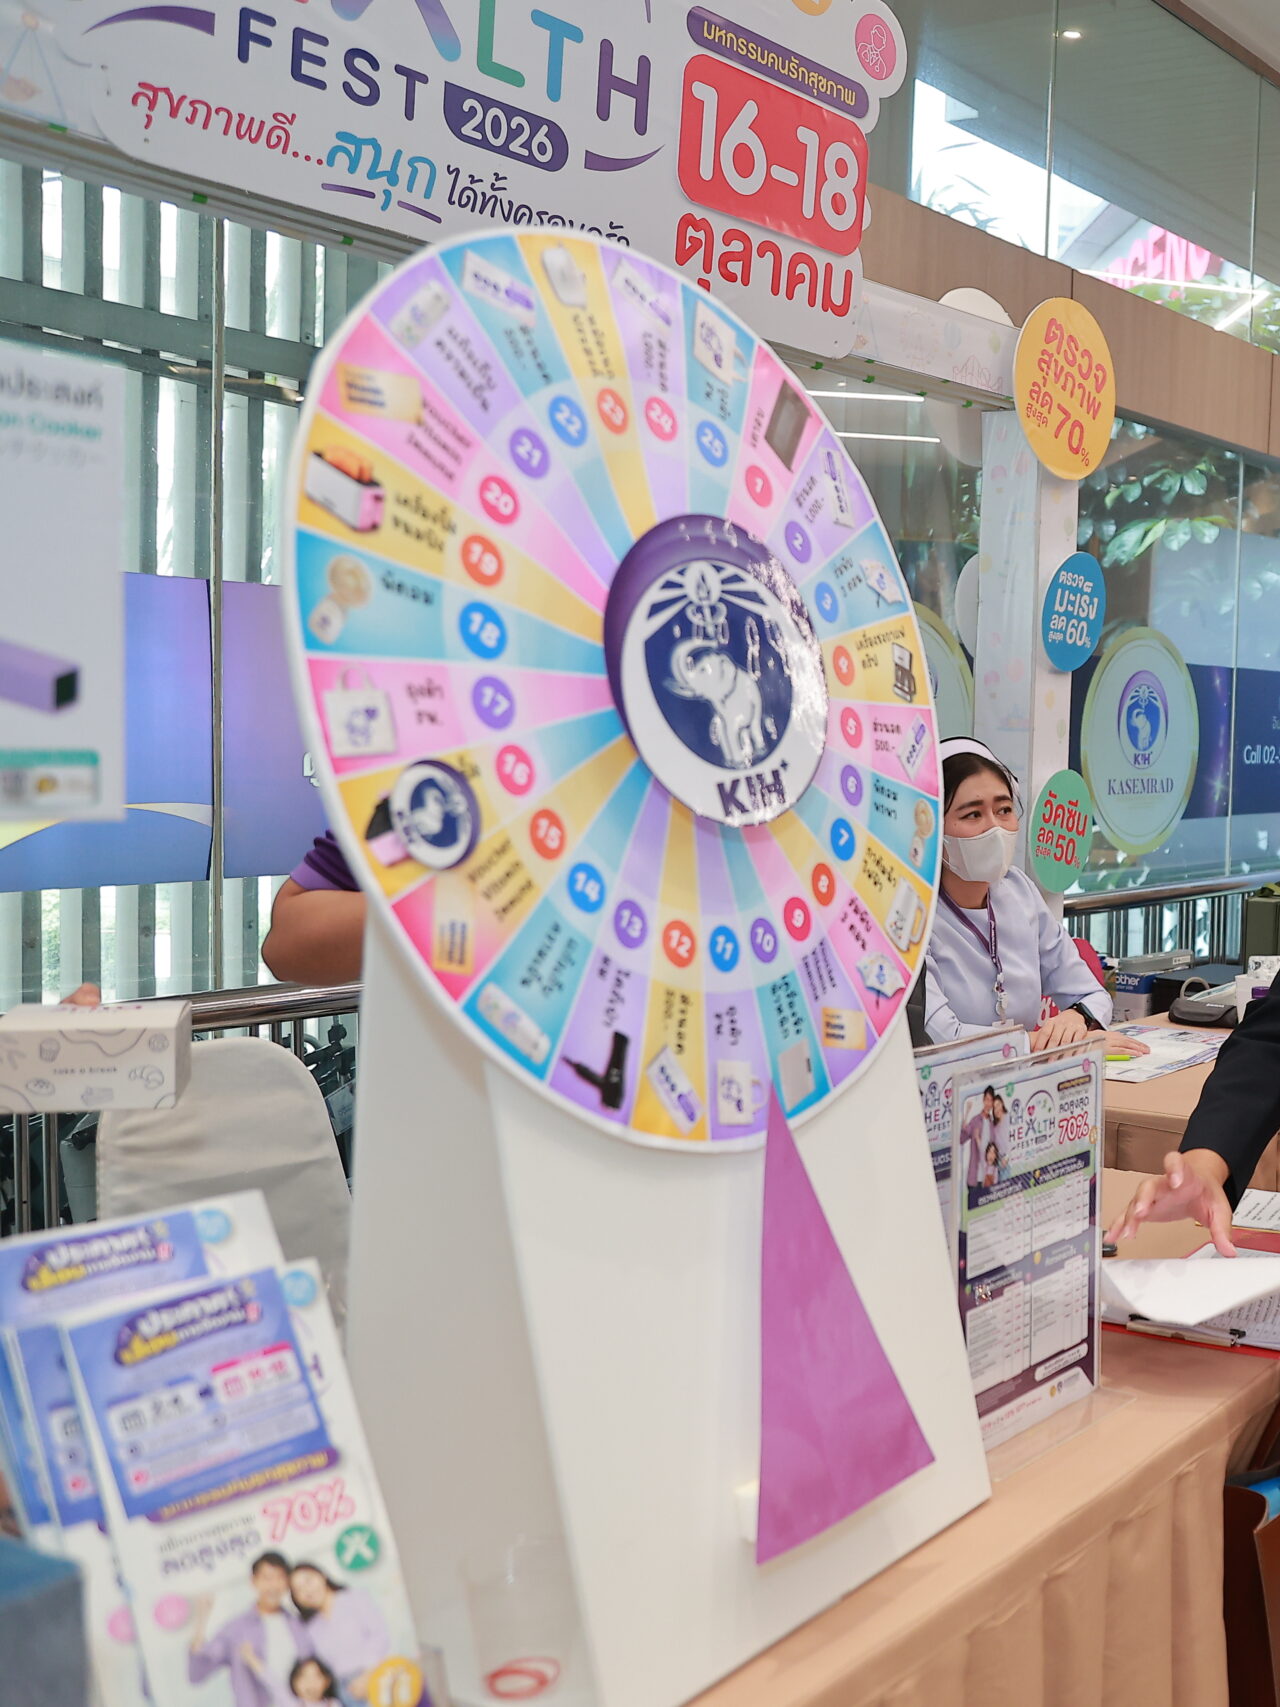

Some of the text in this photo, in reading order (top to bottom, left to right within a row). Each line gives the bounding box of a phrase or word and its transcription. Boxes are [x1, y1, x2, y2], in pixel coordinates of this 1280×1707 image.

[237, 7, 429, 121] FEST
[703, 21, 856, 107] มหกรรมคนรักสุขภาพ
[460, 98, 553, 163] 2026
[326, 131, 437, 211] สนุก
[691, 81, 859, 232] 16-18
[675, 213, 853, 318] ตุลาคม
[1045, 318, 1107, 393] ตรวจ
[1029, 381, 1053, 414] ลด
[1038, 349, 1101, 420] สุขภาพ
[555, 408, 583, 440] 22
[601, 398, 625, 425] 23
[649, 406, 674, 433] 24
[1026, 402, 1048, 427] สูงสุด
[516, 437, 542, 469] 21
[701, 429, 724, 458] 25
[754, 477, 764, 493] 1
[793, 534, 804, 549] 2
[470, 541, 499, 577] 19
[1059, 571, 1085, 588] ตรวจ
[1054, 581, 1099, 620] มะเร็ง
[468, 612, 501, 649] 18
[1050, 614, 1066, 631] ลด
[482, 687, 511, 716] 17
[846, 718, 858, 737] 5
[1244, 745, 1261, 764] Call
[504, 755, 530, 785] 16
[716, 768, 787, 818] KIH
[1107, 777, 1174, 795] KASEMRAD
[1042, 790, 1088, 837] วัคซีน
[536, 821, 562, 850] 15
[838, 828, 849, 846] 7
[1037, 827, 1054, 846] ลด
[574, 872, 600, 902] 14
[818, 874, 829, 893] 8
[621, 911, 643, 937] 13
[792, 909, 804, 928] 9
[669, 930, 692, 957] 12
[715, 935, 734, 961] 11
[755, 927, 775, 951] 10
[1058, 1110, 1090, 1145] 70%
[262, 1477, 356, 1541] 70%
